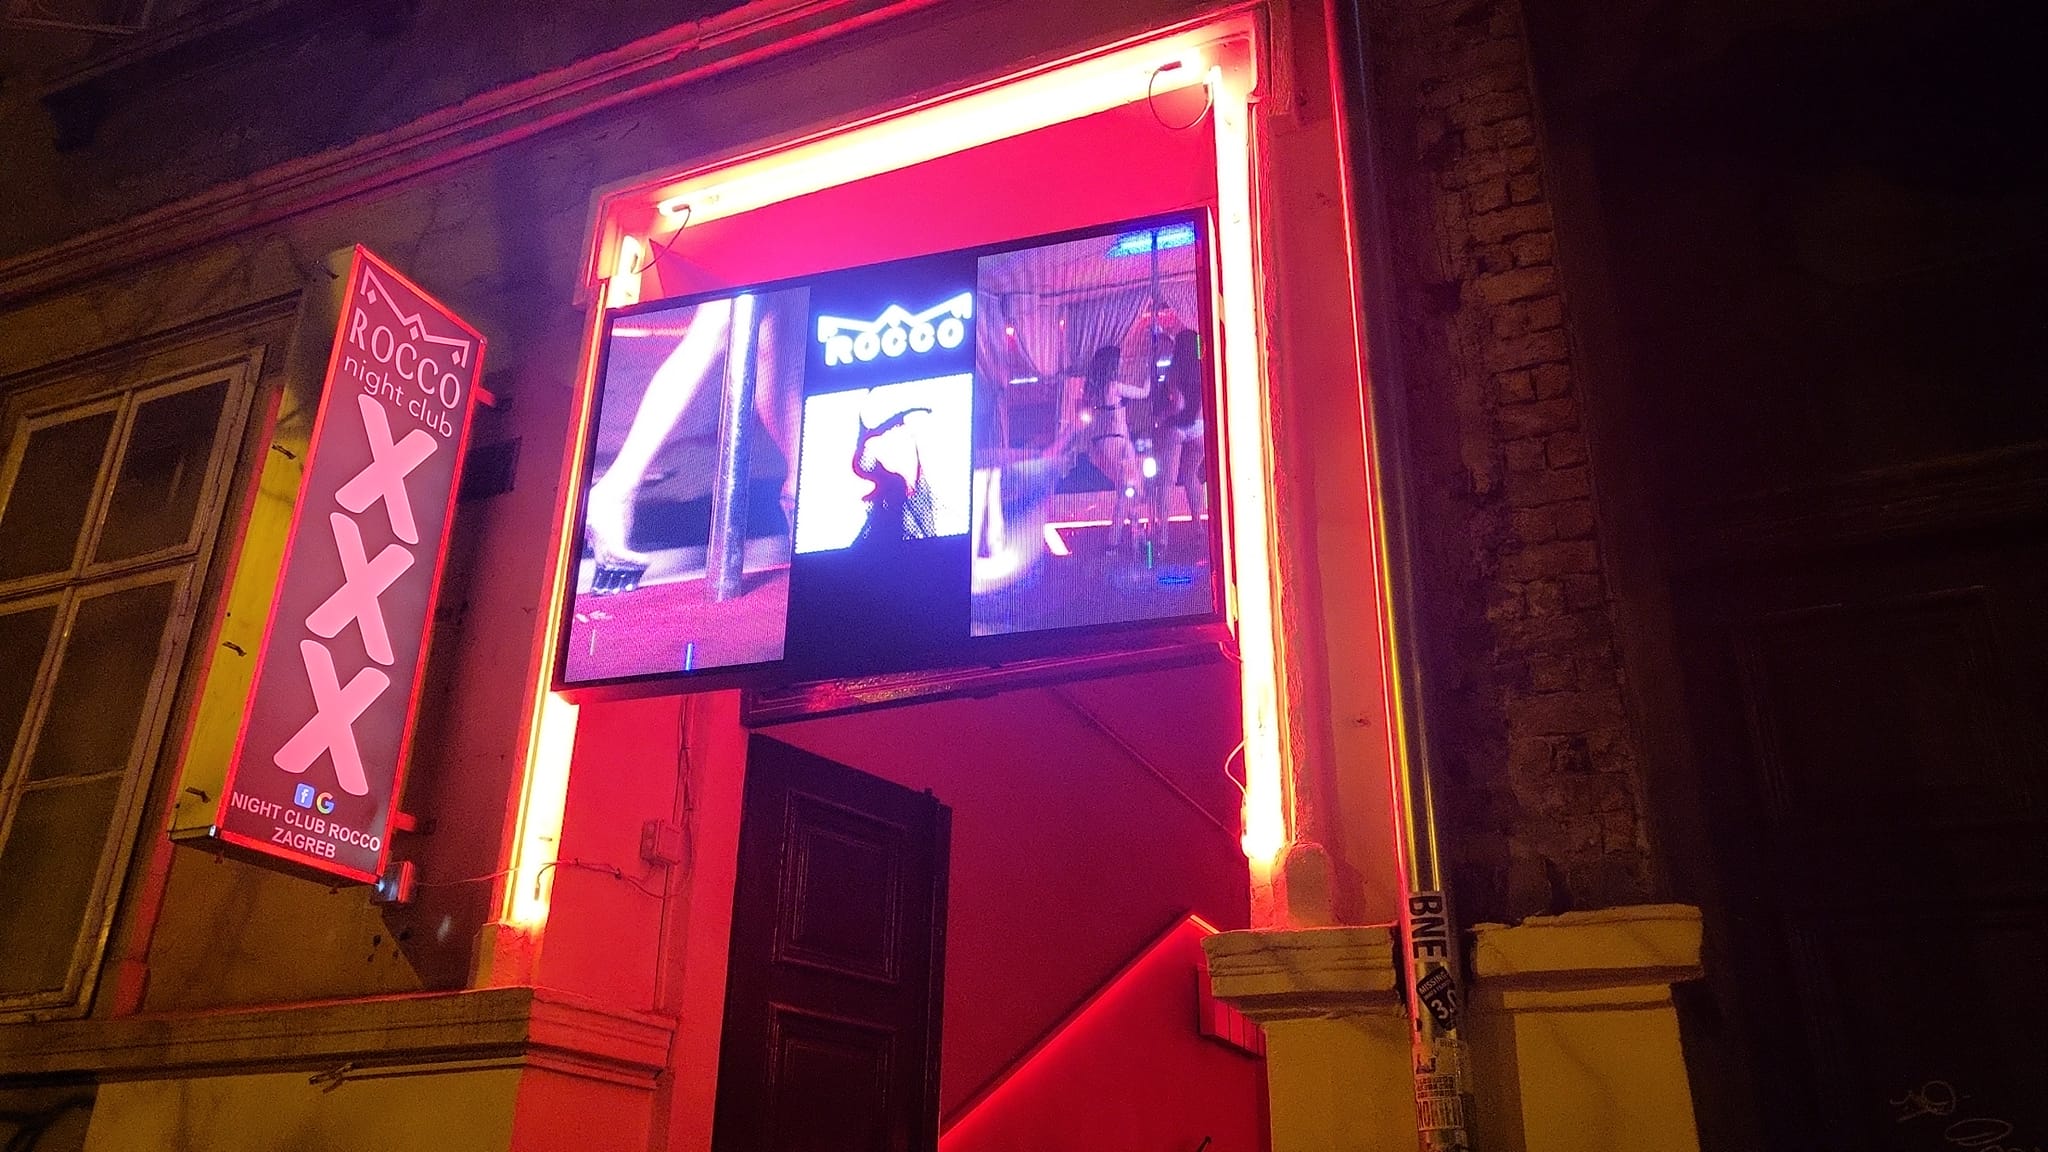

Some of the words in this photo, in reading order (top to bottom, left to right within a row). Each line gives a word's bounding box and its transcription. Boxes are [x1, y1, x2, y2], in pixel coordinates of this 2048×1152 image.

[349, 307, 461, 410] ROCCO
[825, 318, 964, 366] ROCCO
[344, 355, 402, 407] night
[408, 398, 453, 438] club
[230, 791, 282, 820] NIGHT
[284, 809, 326, 834] CLUB
[328, 823, 381, 852] ROCCO
[272, 827, 336, 858] ZAGREB
[1409, 896, 1447, 958] BNE
